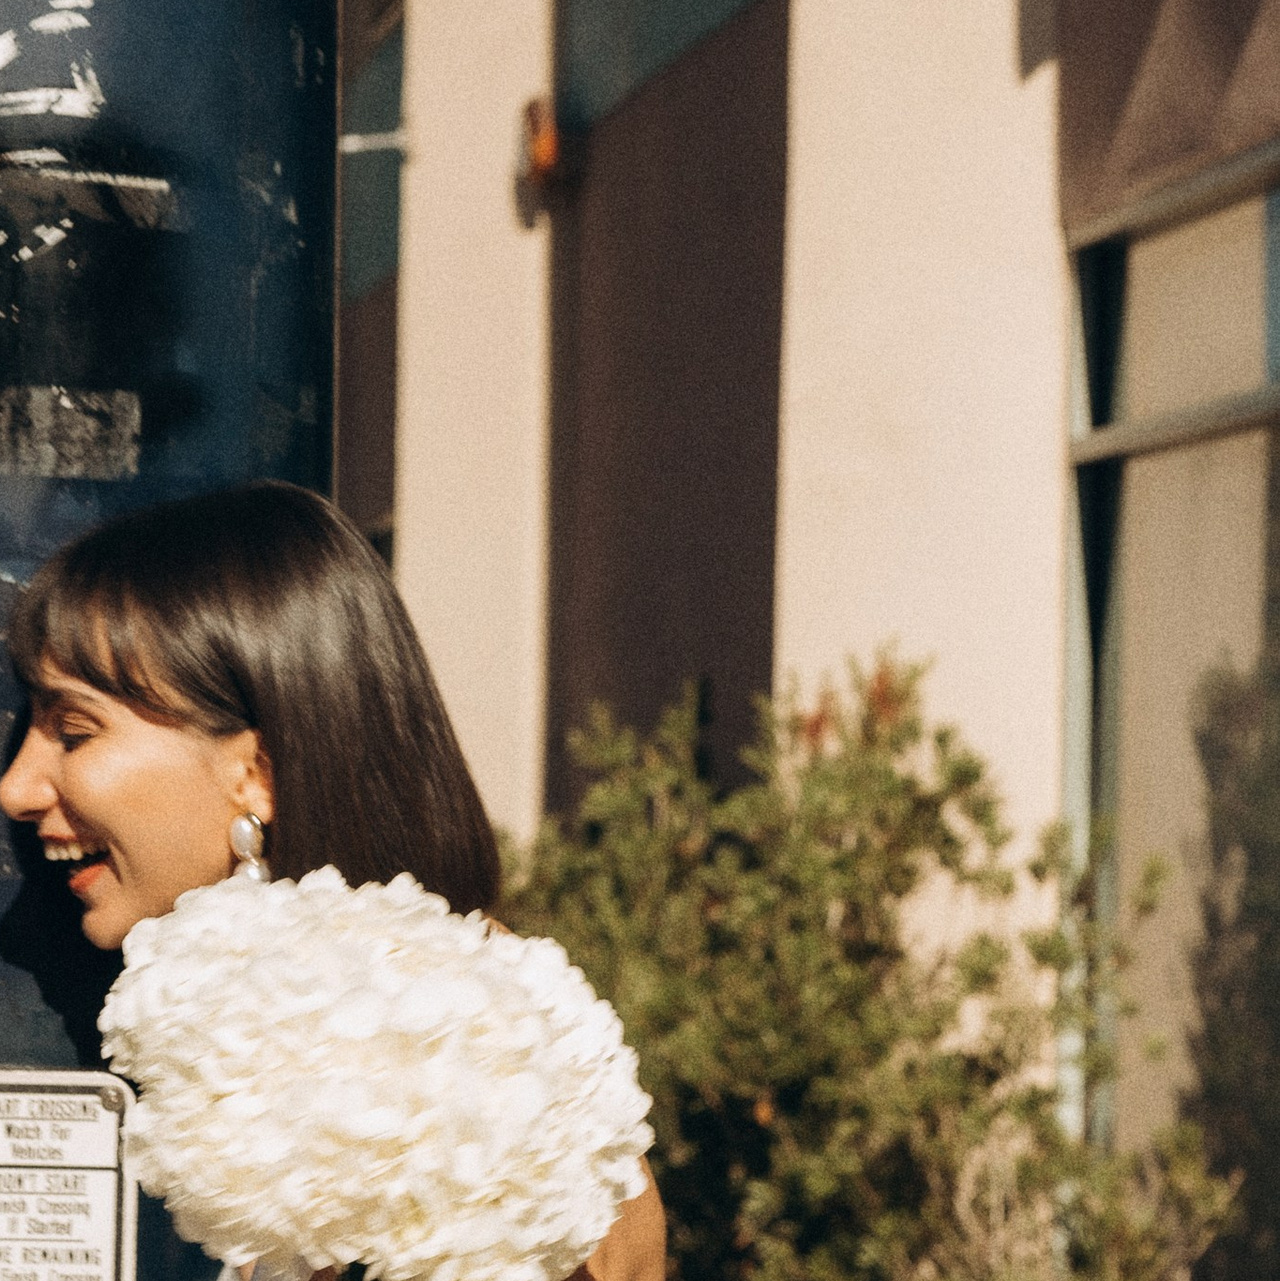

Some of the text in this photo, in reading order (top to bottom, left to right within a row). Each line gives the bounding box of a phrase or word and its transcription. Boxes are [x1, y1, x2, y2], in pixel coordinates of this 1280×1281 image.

[29, 1099, 99, 1120] CROSSING
[4, 1123, 41, 1139] Watch
[11, 1143, 63, 1159] Vehicles
[45, 1174, 87, 1193] START
[36, 1198, 91, 1218] Crossing
[26, 1217, 73, 1235] Started
[22, 1247, 101, 1265] REMAINING
